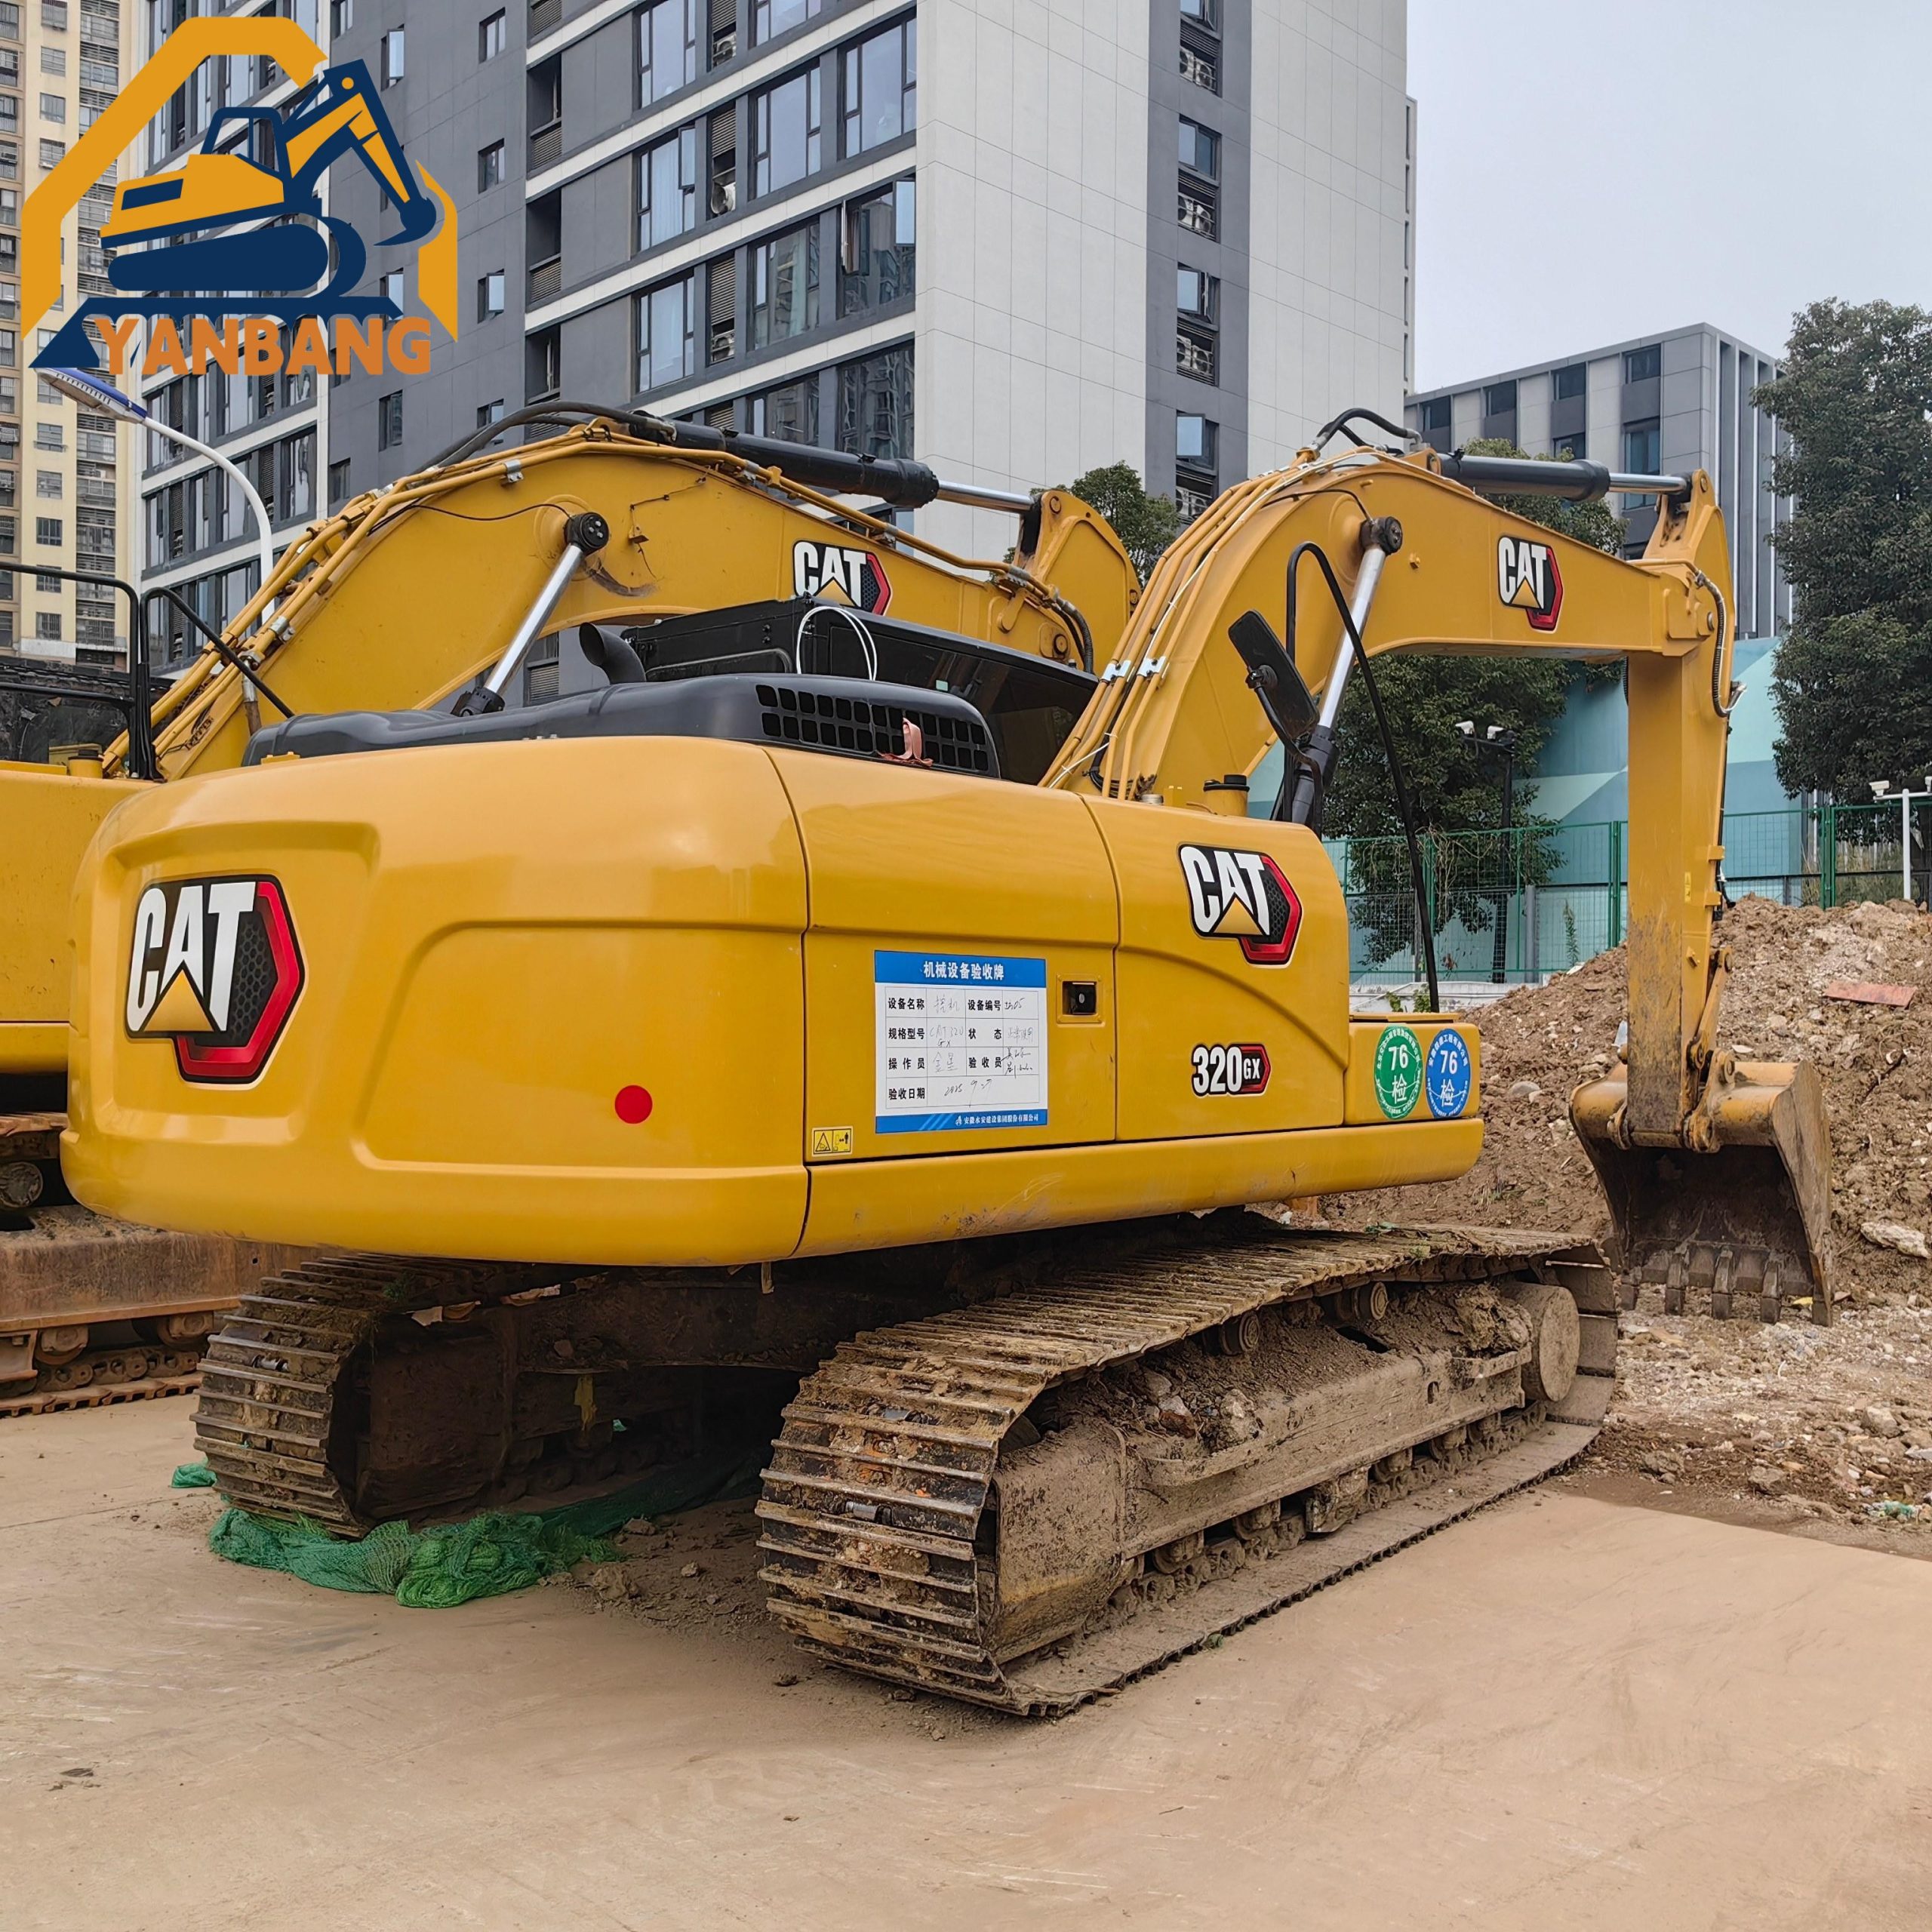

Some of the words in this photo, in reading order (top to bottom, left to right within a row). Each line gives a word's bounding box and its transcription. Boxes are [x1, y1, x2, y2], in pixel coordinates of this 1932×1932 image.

[794, 541, 867, 608] CAT
[1497, 537, 1547, 610] CAT
[1180, 846, 1270, 936] CAT
[127, 881, 256, 1032] CAT
[923, 960, 1004, 980] 机械设备验收牌
[888, 998, 925, 1011] 设备名称
[968, 999, 1001, 1011] 设备编号
[888, 1027, 925, 1040] 规格型号
[1192, 1046, 1242, 1094] 320
[1389, 1044, 1409, 1071] 76
[1440, 1050, 1458, 1075] 76
[888, 1088, 925, 1100] 验收日期
[1392, 1073, 1407, 1104] 检
[1440, 1078, 1455, 1107] 检
